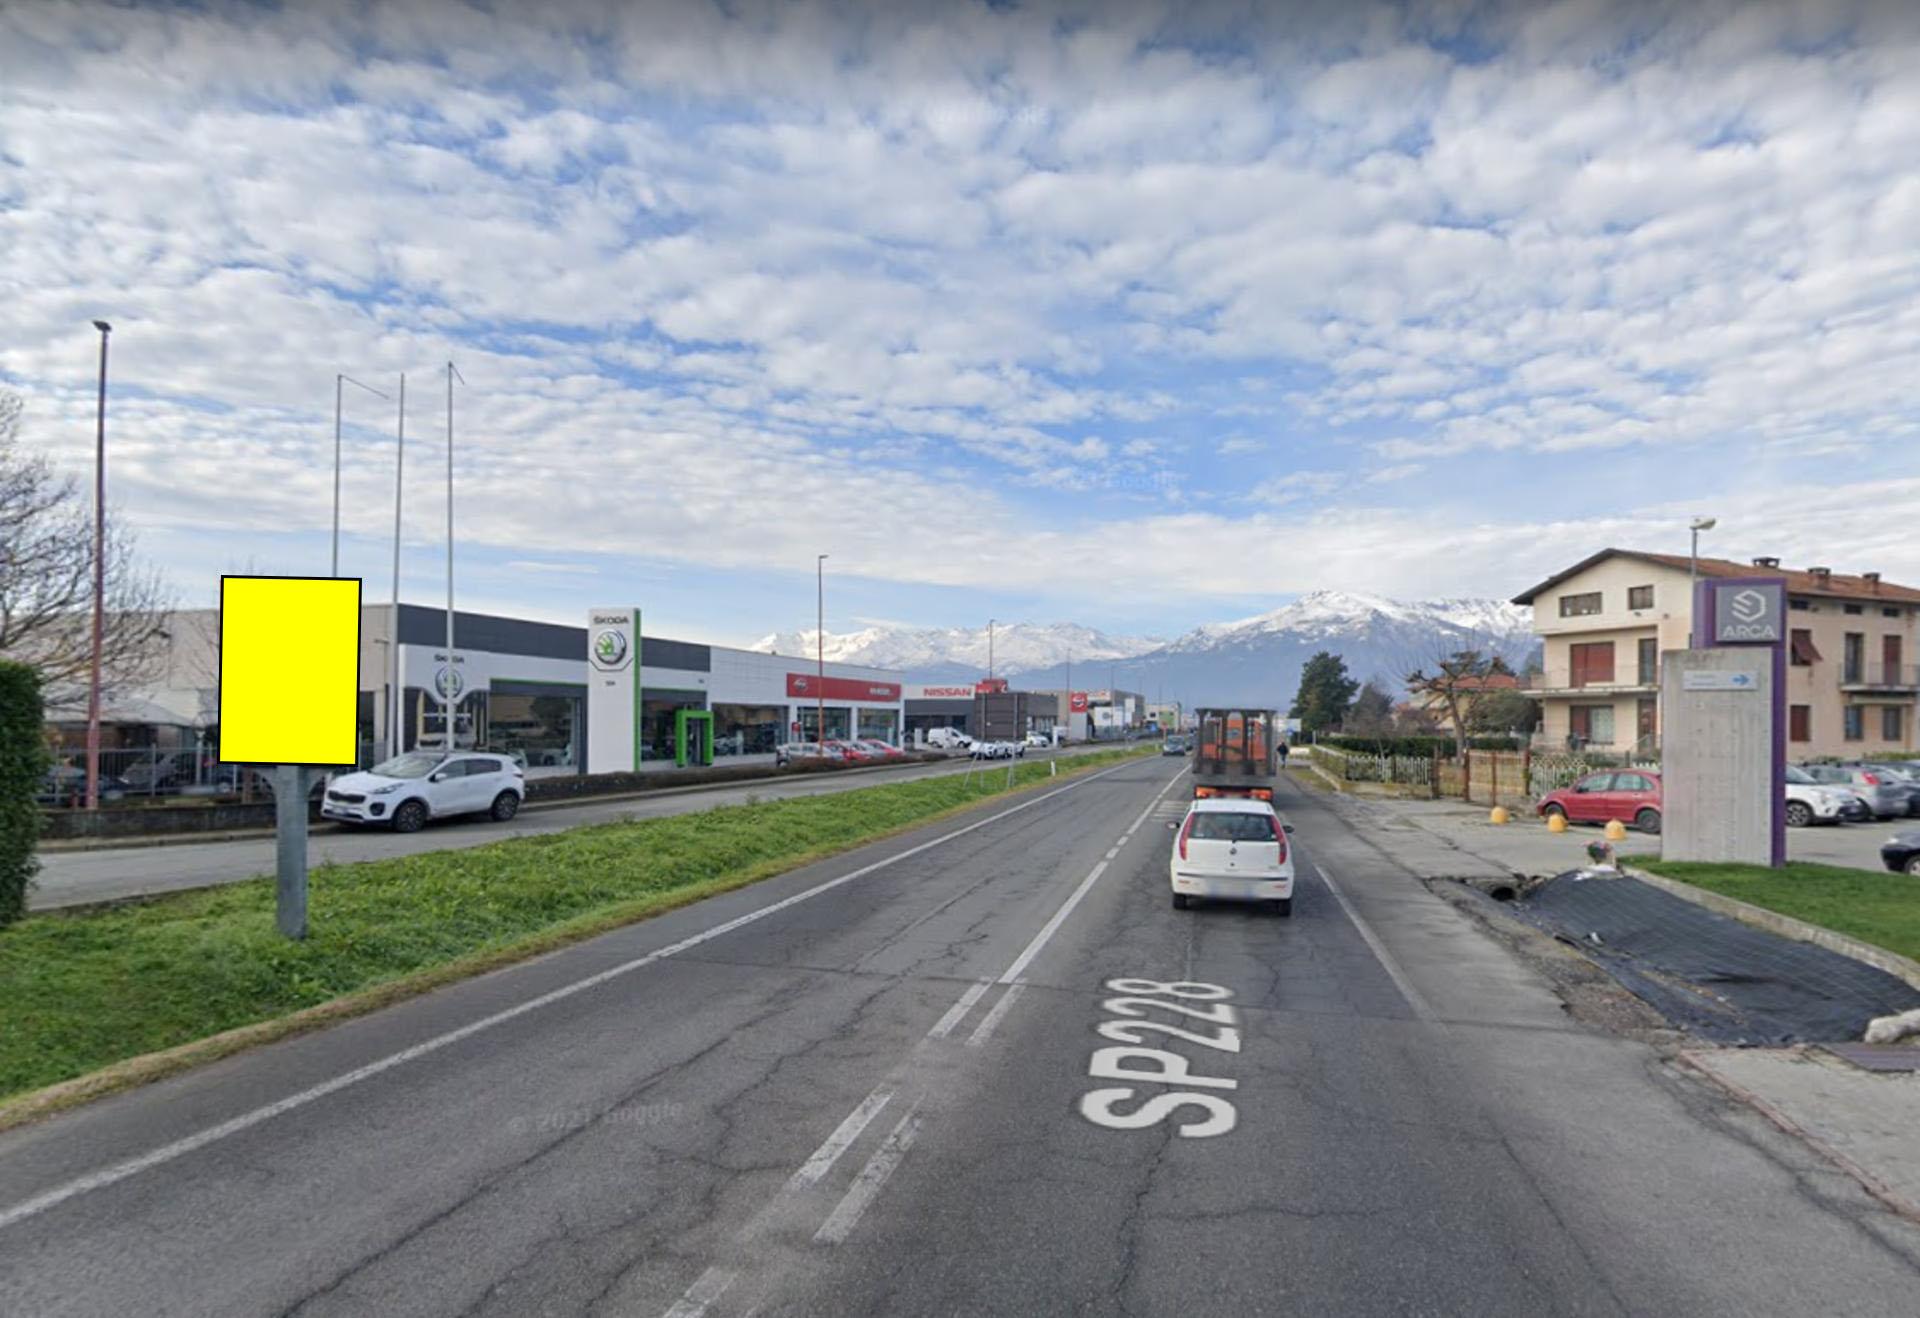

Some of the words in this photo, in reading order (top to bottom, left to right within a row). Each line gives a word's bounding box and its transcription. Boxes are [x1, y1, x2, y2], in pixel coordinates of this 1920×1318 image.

[1722, 623, 1777, 639] ARCA
[923, 687, 972, 697] NISSAN
[1081, 978, 1241, 1138] SP228
